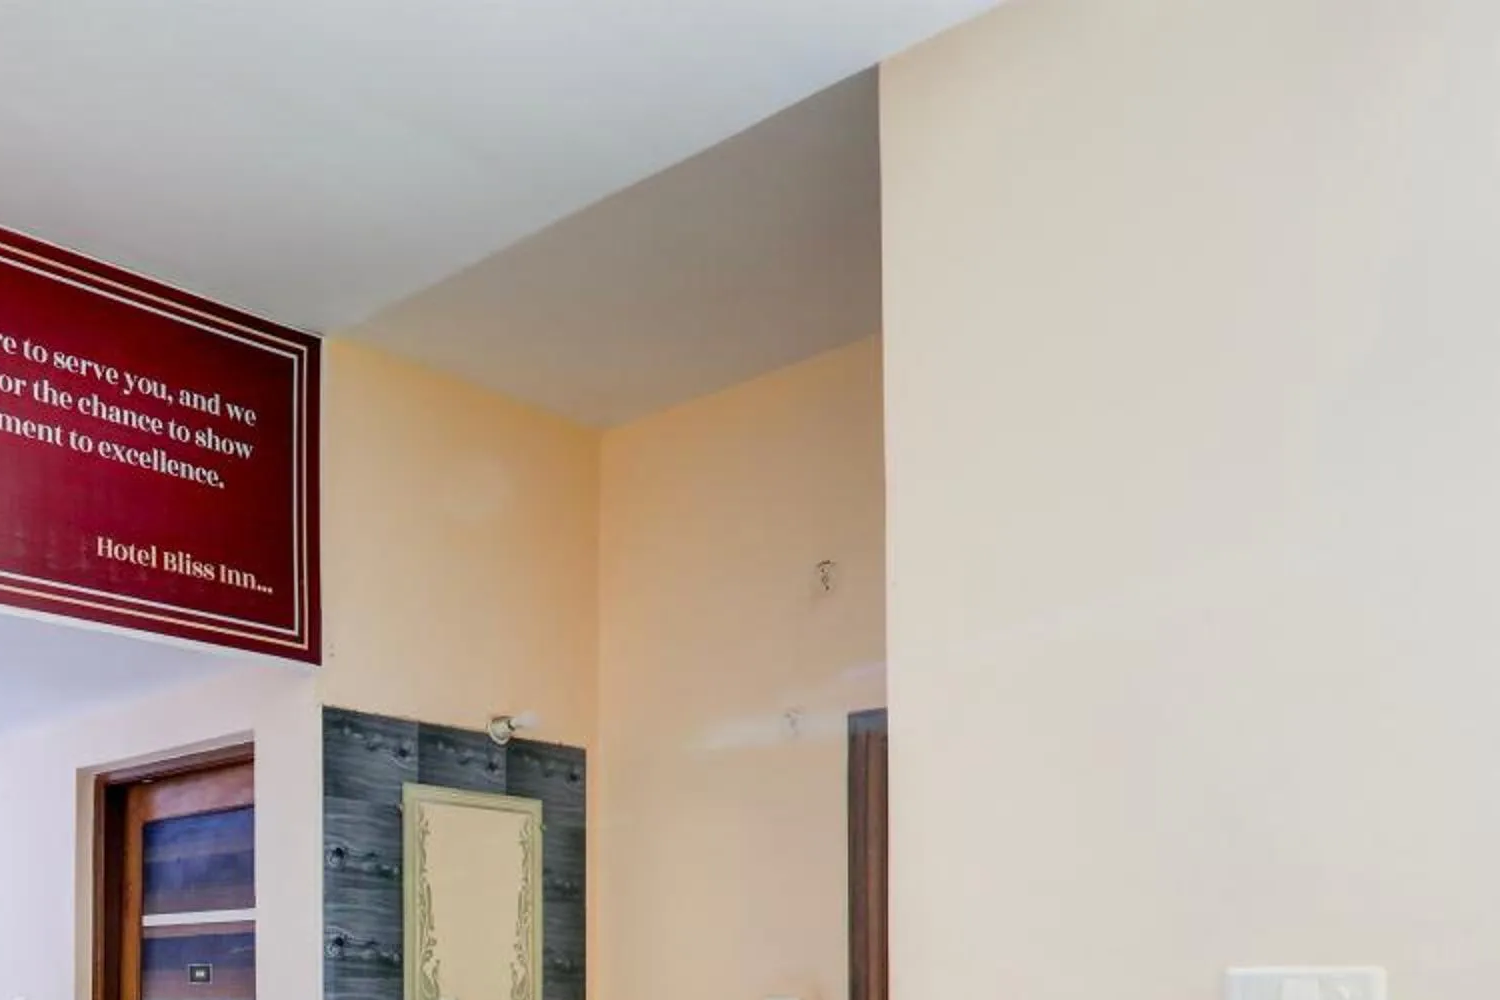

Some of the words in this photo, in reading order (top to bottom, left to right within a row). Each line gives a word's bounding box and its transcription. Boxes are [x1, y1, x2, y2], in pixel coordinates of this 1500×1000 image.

[23, 339, 48, 363] to
[53, 350, 119, 385] serve
[123, 371, 173, 404] you,
[179, 388, 221, 416] and
[226, 401, 257, 427] we
[33, 379, 73, 409] the
[78, 393, 163, 436] chance
[168, 419, 190, 443] to
[195, 427, 254, 460] show
[69, 429, 93, 453] to
[98, 439, 225, 488] excellence.
[97, 536, 157, 569] Hotel
[163, 551, 215, 581] Bliss
[220, 564, 273, 594] Inn...
